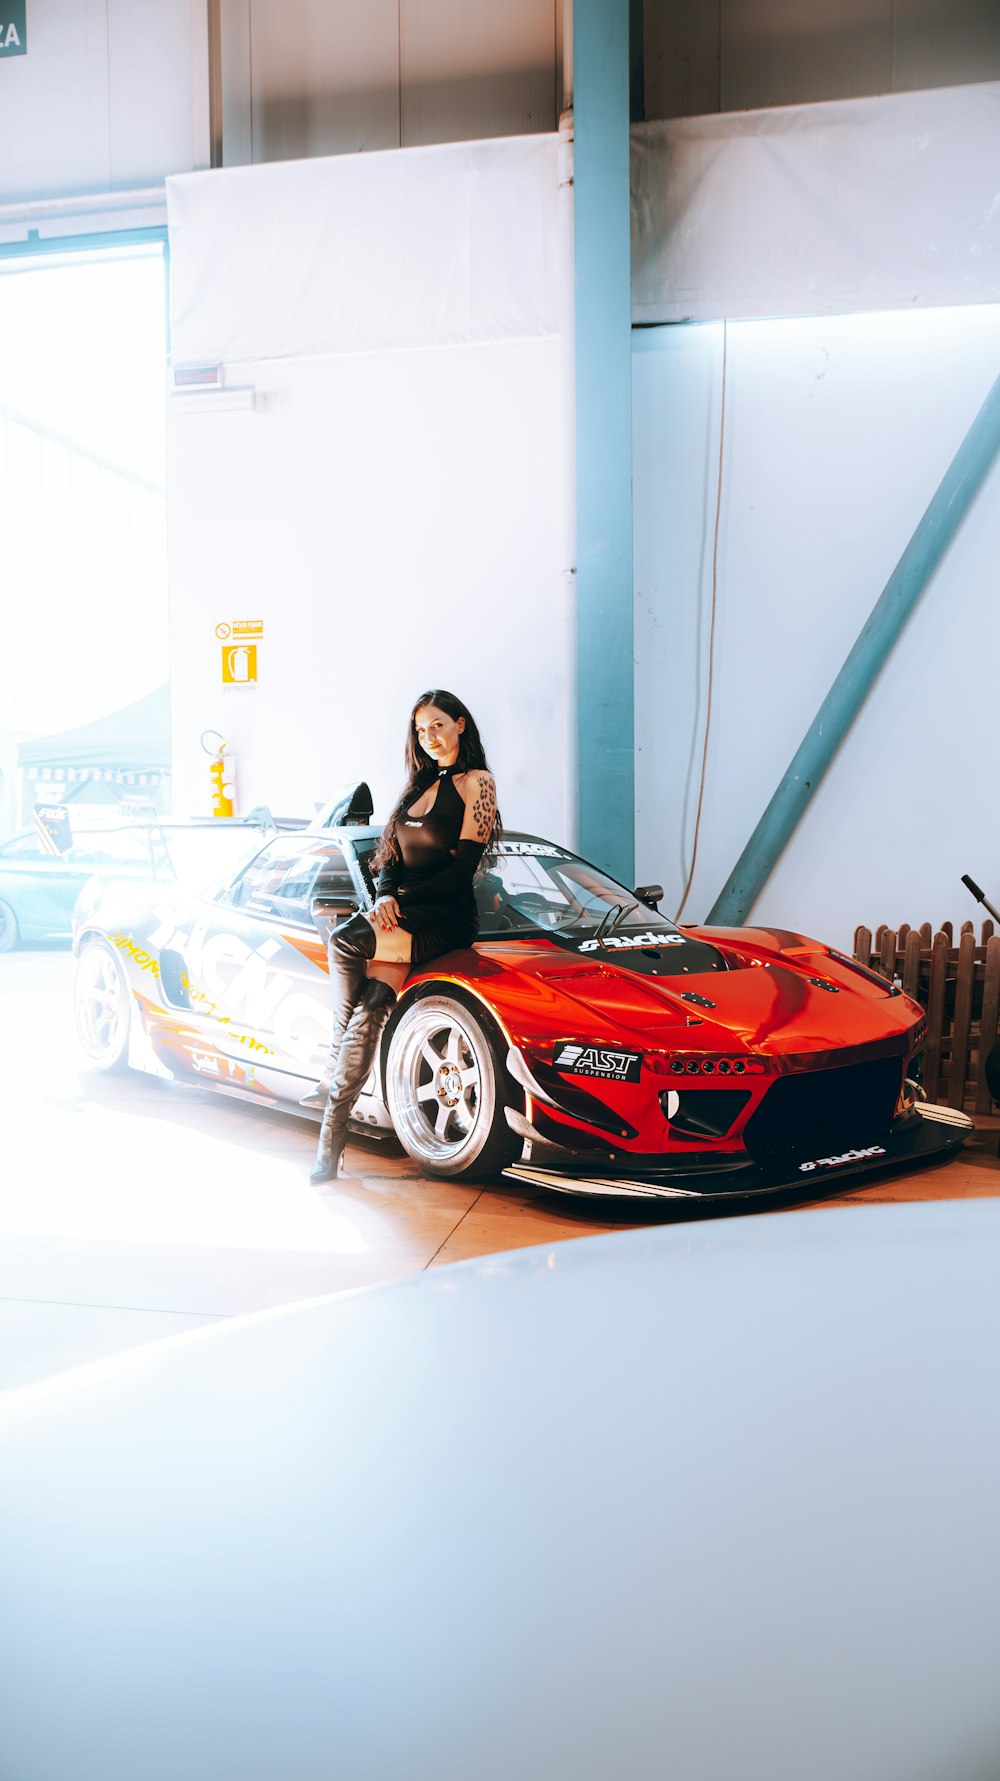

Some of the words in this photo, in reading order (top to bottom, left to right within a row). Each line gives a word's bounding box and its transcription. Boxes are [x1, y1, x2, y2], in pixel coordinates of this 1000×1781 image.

[0, 23, 20, 47] A
[575, 1048, 639, 1075] AST
[573, 1067, 627, 1081] SUSPENSION
